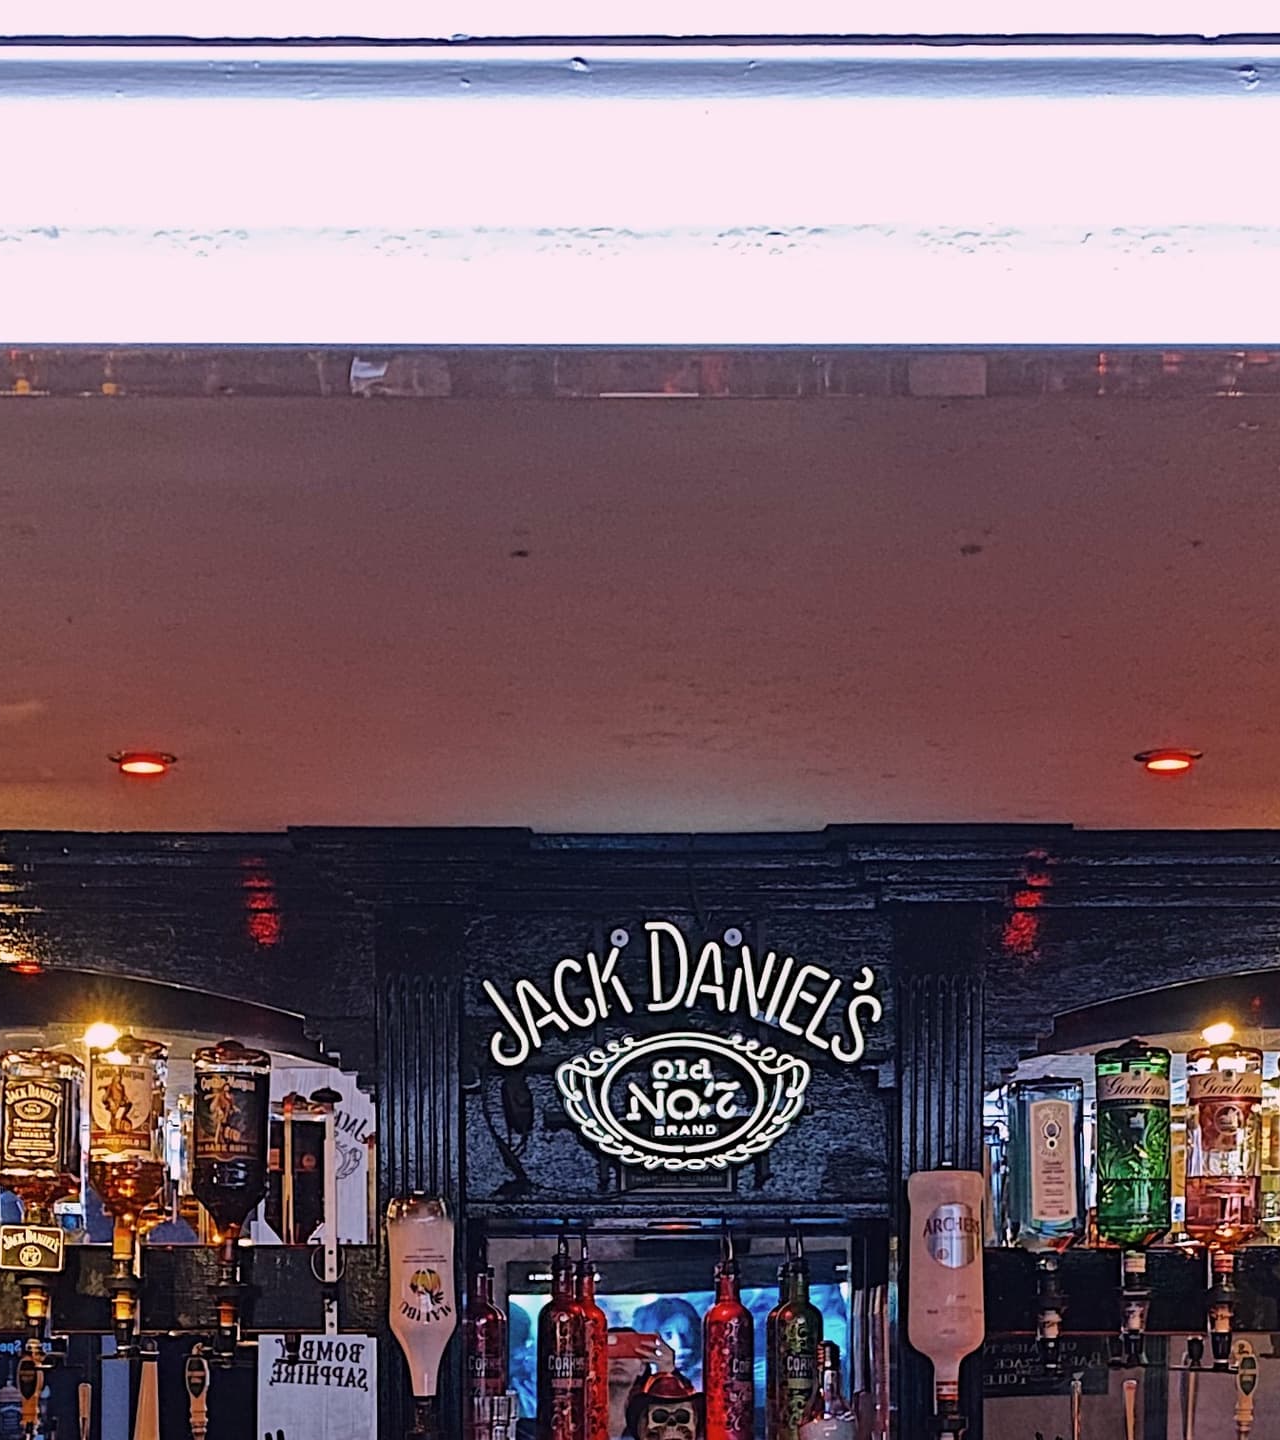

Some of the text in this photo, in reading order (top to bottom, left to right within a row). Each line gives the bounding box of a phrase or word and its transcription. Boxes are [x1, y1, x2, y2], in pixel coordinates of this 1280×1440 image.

[482, 920, 883, 1067] JACK DANIEL'S
[651, 1057, 713, 1086] Old
[1105, 1076, 1166, 1096] Gordon's
[1197, 1075, 1259, 1096] Gordon's
[4, 1088, 28, 1105] JACK
[653, 1123, 718, 1137] BRAND
[3, 1234, 26, 1250] JACK
